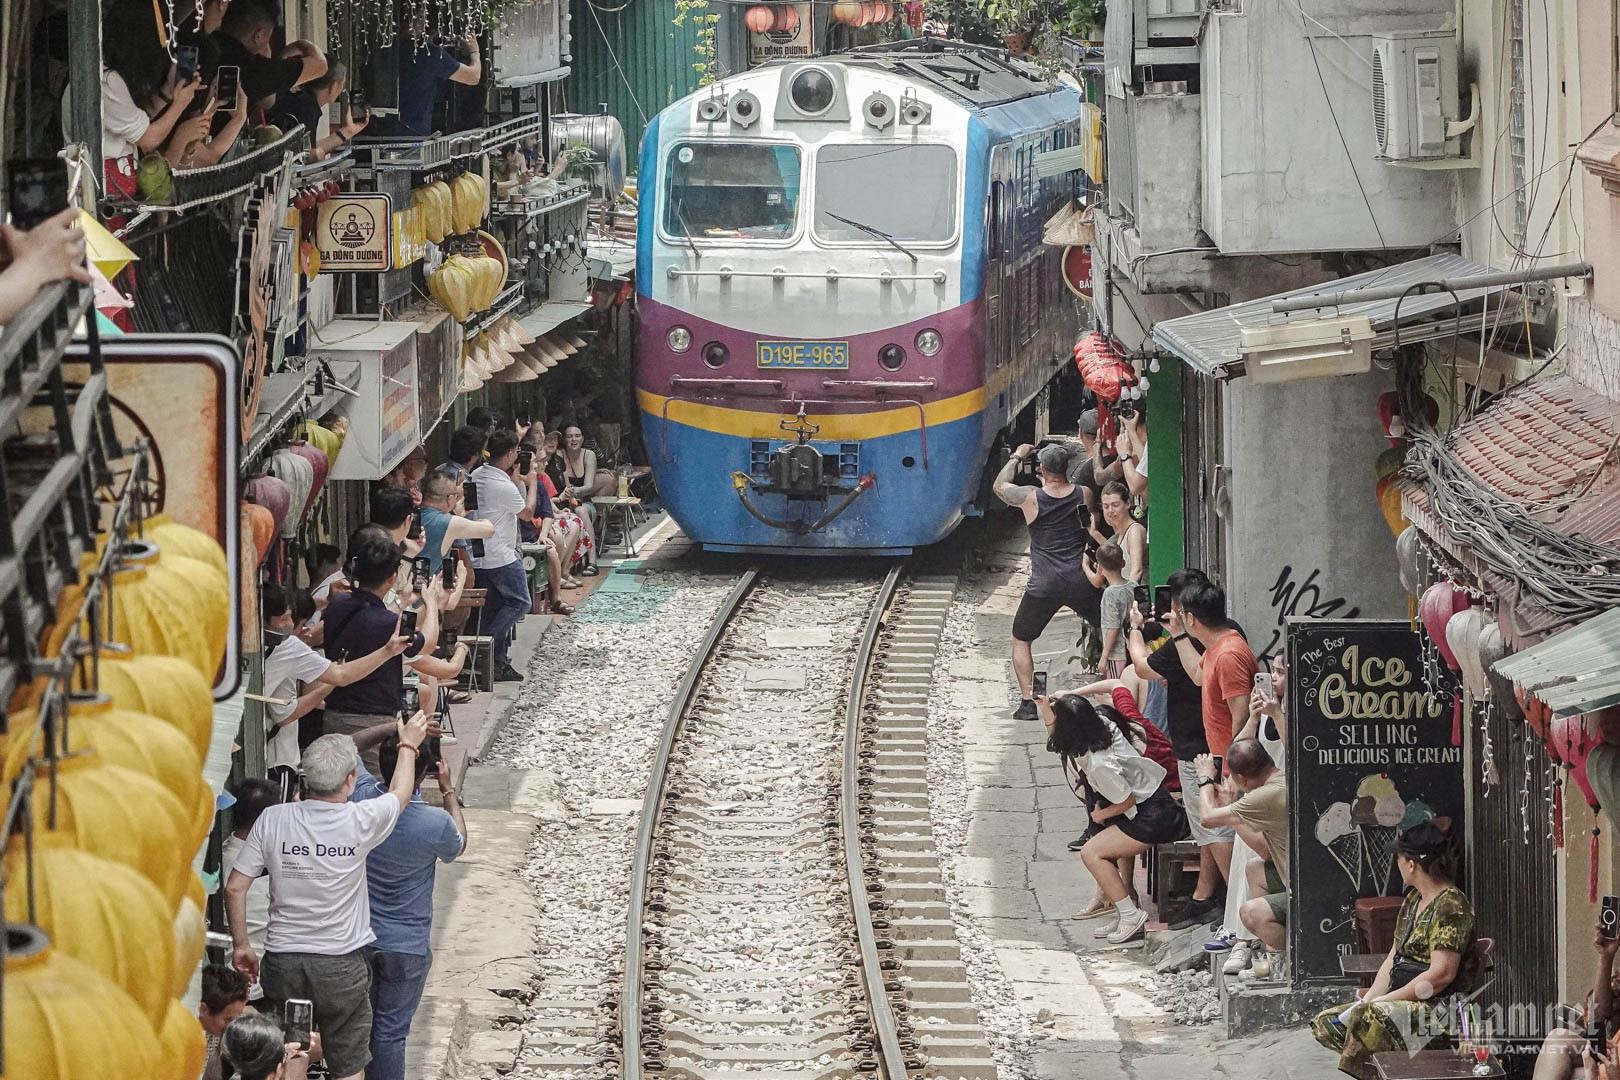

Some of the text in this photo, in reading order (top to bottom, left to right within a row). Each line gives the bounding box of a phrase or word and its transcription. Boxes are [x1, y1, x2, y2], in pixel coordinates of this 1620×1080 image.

[320, 251, 331, 261] GA
[760, 345, 845, 365] D19E-965
[1301, 637, 1345, 665] The Best
[1341, 645, 1412, 686] Ice
[1318, 673, 1442, 720] Cream
[1339, 724, 1418, 745] SELLING
[1318, 747, 1461, 765] DELICIOUS ICE CREAM
[282, 842, 310, 856] Les
